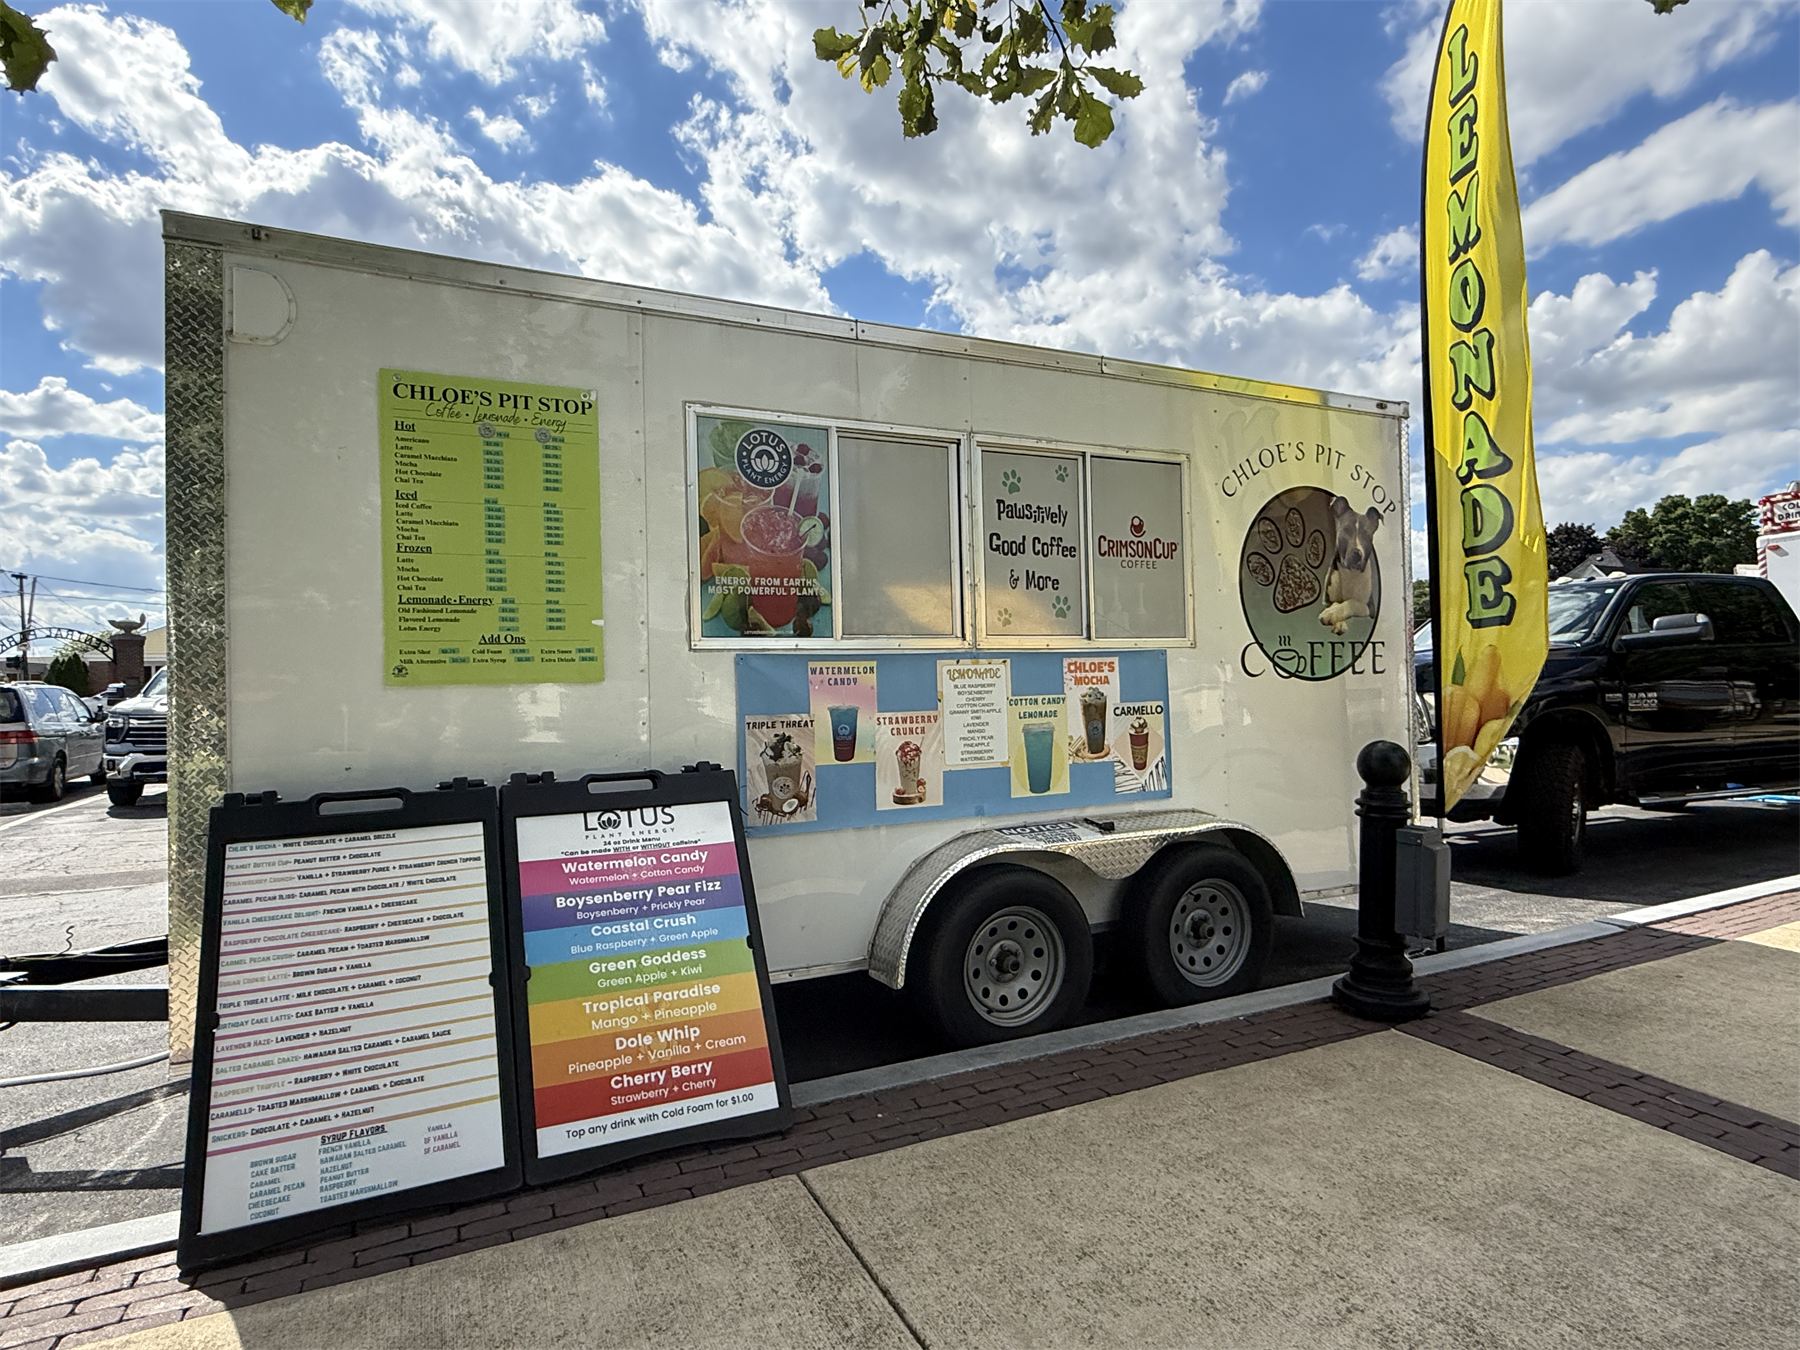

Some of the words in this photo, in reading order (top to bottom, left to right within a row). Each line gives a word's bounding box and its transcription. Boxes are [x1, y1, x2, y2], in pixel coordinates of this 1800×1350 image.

[1447, 23, 1517, 631] LEMONADE
[393, 382, 493, 407] CHLOE'S
[499, 393, 533, 410] PIT
[538, 397, 593, 415] STOP
[394, 420, 416, 431] Hot
[425, 402, 462, 419] Coffee
[473, 406, 520, 426] Lemonade
[531, 412, 566, 433] Energy
[742, 432, 787, 453] LOTUS
[741, 458, 762, 483] PLANT
[764, 461, 789, 484] ENERGY
[1221, 441, 1306, 498] CHLOE'S
[1315, 443, 1346, 470] PIT
[1350, 464, 1396, 515] STOP
[395, 489, 418, 500] Iced
[996, 499, 1068, 527] Pawsitively
[396, 543, 432, 553] Frozen
[989, 532, 1026, 556] Good
[1032, 536, 1076, 558] Coffee
[1120, 560, 1158, 570] COFFEE
[715, 576, 751, 586] ENERGY
[755, 577, 780, 586] FROM
[1009, 568, 1019, 590] &
[1026, 570, 1060, 591] More
[398, 595, 452, 605] Lemonade
[458, 596, 494, 606] Energy
[708, 585, 733, 595] MOST
[738, 586, 787, 596] POWERFUL
[478, 634, 501, 644] Add
[504, 634, 526, 644] Ons
[810, 666, 875, 676] WATERMELON
[946, 667, 1001, 682] LEMONADE
[1067, 661, 1115, 673] CHLOE'S
[827, 678, 858, 686] CANDY
[1074, 676, 1110, 686] MOCHA
[1008, 697, 1039, 706] COTTON
[1041, 696, 1066, 706] CANDY
[1114, 704, 1164, 716] CARMELLO
[746, 720, 777, 730] TRIPLE
[780, 720, 815, 729] THREAT
[876, 714, 938, 726] STRAWBERRY
[1018, 710, 1058, 720] LEMONADE
[890, 726, 926, 736] CRUNCH
[583, 806, 675, 831] LOTUS
[1001, 822, 1072, 834] NOTICE
[585, 832, 622, 840] PLANT
[632, 828, 675, 836] ENERGY
[641, 842, 670, 850] WITHOUT
[562, 855, 656, 874] Watermelon
[661, 850, 708, 866] Candy
[570, 872, 629, 886] Watermelon
[640, 868, 672, 878] Cotton
[675, 864, 705, 877] Candy
[556, 888, 653, 910] Boysenberry
[658, 883, 690, 896] Pear
[695, 880, 722, 892] Fizz
[576, 905, 639, 921] Boysenberry
[651, 899, 682, 913] Prickly
[684, 898, 706, 908] Pear
[591, 918, 650, 937] Coastal
[653, 914, 697, 930] Crush
[570, 944, 593, 955] Blue
[596, 936, 647, 954] Raspberry
[658, 932, 689, 944] Green
[691, 928, 718, 942] Apple
[588, 956, 636, 974] Green
[640, 948, 707, 966] Goddess
[597, 975, 632, 988] Green
[635, 971, 668, 986] Apple
[681, 964, 702, 976] Kiwi
[582, 993, 650, 1014] Tropical
[653, 984, 721, 1001] Paradise
[592, 1014, 638, 1031] Mango
[654, 1001, 717, 1020] Pineapple
[615, 1033, 652, 1051] Dole
[657, 1024, 700, 1044] Whip
[568, 1055, 632, 1075] Pineapple
[649, 1044, 690, 1060] Vanilla
[705, 1034, 746, 1050] Cream
[610, 1068, 667, 1090] Cherry
[670, 1060, 713, 1081] Berry
[610, 1087, 670, 1106] Strawberry
[682, 1078, 717, 1093] Cherry
[300, 1116, 332, 1127] CARAMEL
[566, 1129, 586, 1140] Top
[588, 1124, 608, 1136] any
[610, 1117, 636, 1131] drink
[638, 1112, 660, 1125] with
[662, 1107, 684, 1120] Cold
[686, 1100, 714, 1114] Foam
[716, 1098, 728, 1108] for
[731, 1092, 754, 1106] $1.00
[320, 1132, 348, 1144] SYRUP
[350, 1124, 386, 1138] FLAVORS
